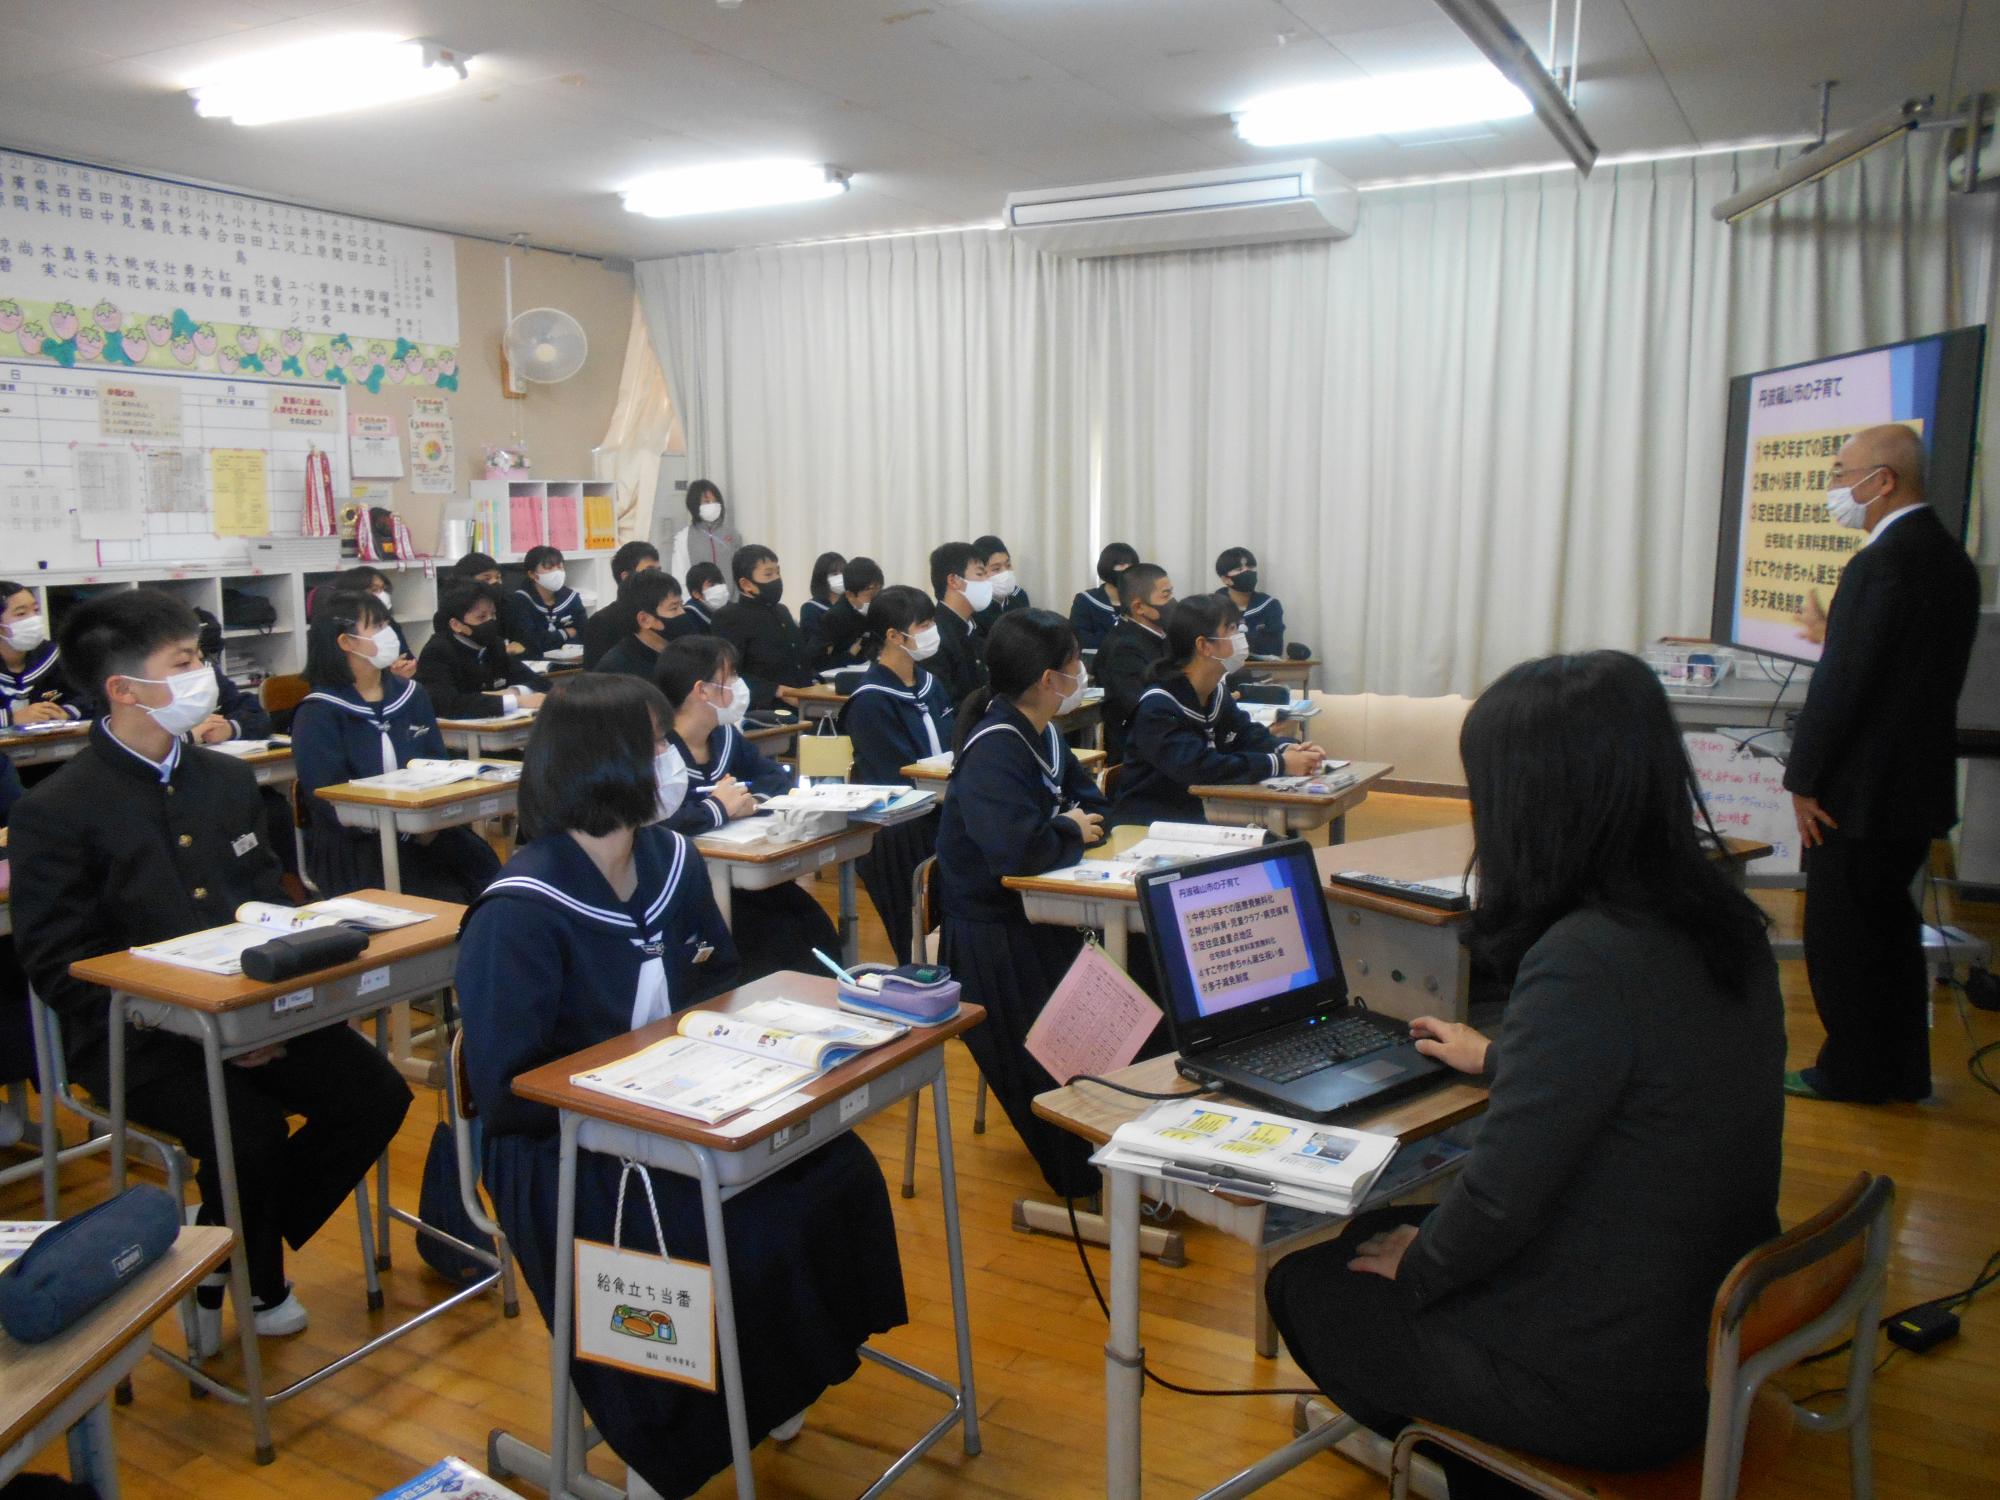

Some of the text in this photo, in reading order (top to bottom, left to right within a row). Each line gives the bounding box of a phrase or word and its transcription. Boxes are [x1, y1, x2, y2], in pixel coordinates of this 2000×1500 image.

[56, 184, 72, 218] 西村
[78, 187, 94, 219] 西田
[99, 191, 114, 225] 田中
[178, 206, 192, 237] 杉本
[197, 209, 210, 240] 小寺
[251, 218, 263, 247] 太田
[267, 221, 280, 250] 大上
[300, 226, 312, 255] 井上
[347, 235, 358, 262] 石田
[1758, 376, 1843, 408] 丹波篠山市の子育て
[1755, 432, 1852, 463] 1中学3年までの医療
[1178, 876, 1241, 899] 丹波篠山市の子育て
[597, 1272, 692, 1308] 給食立ち当番
